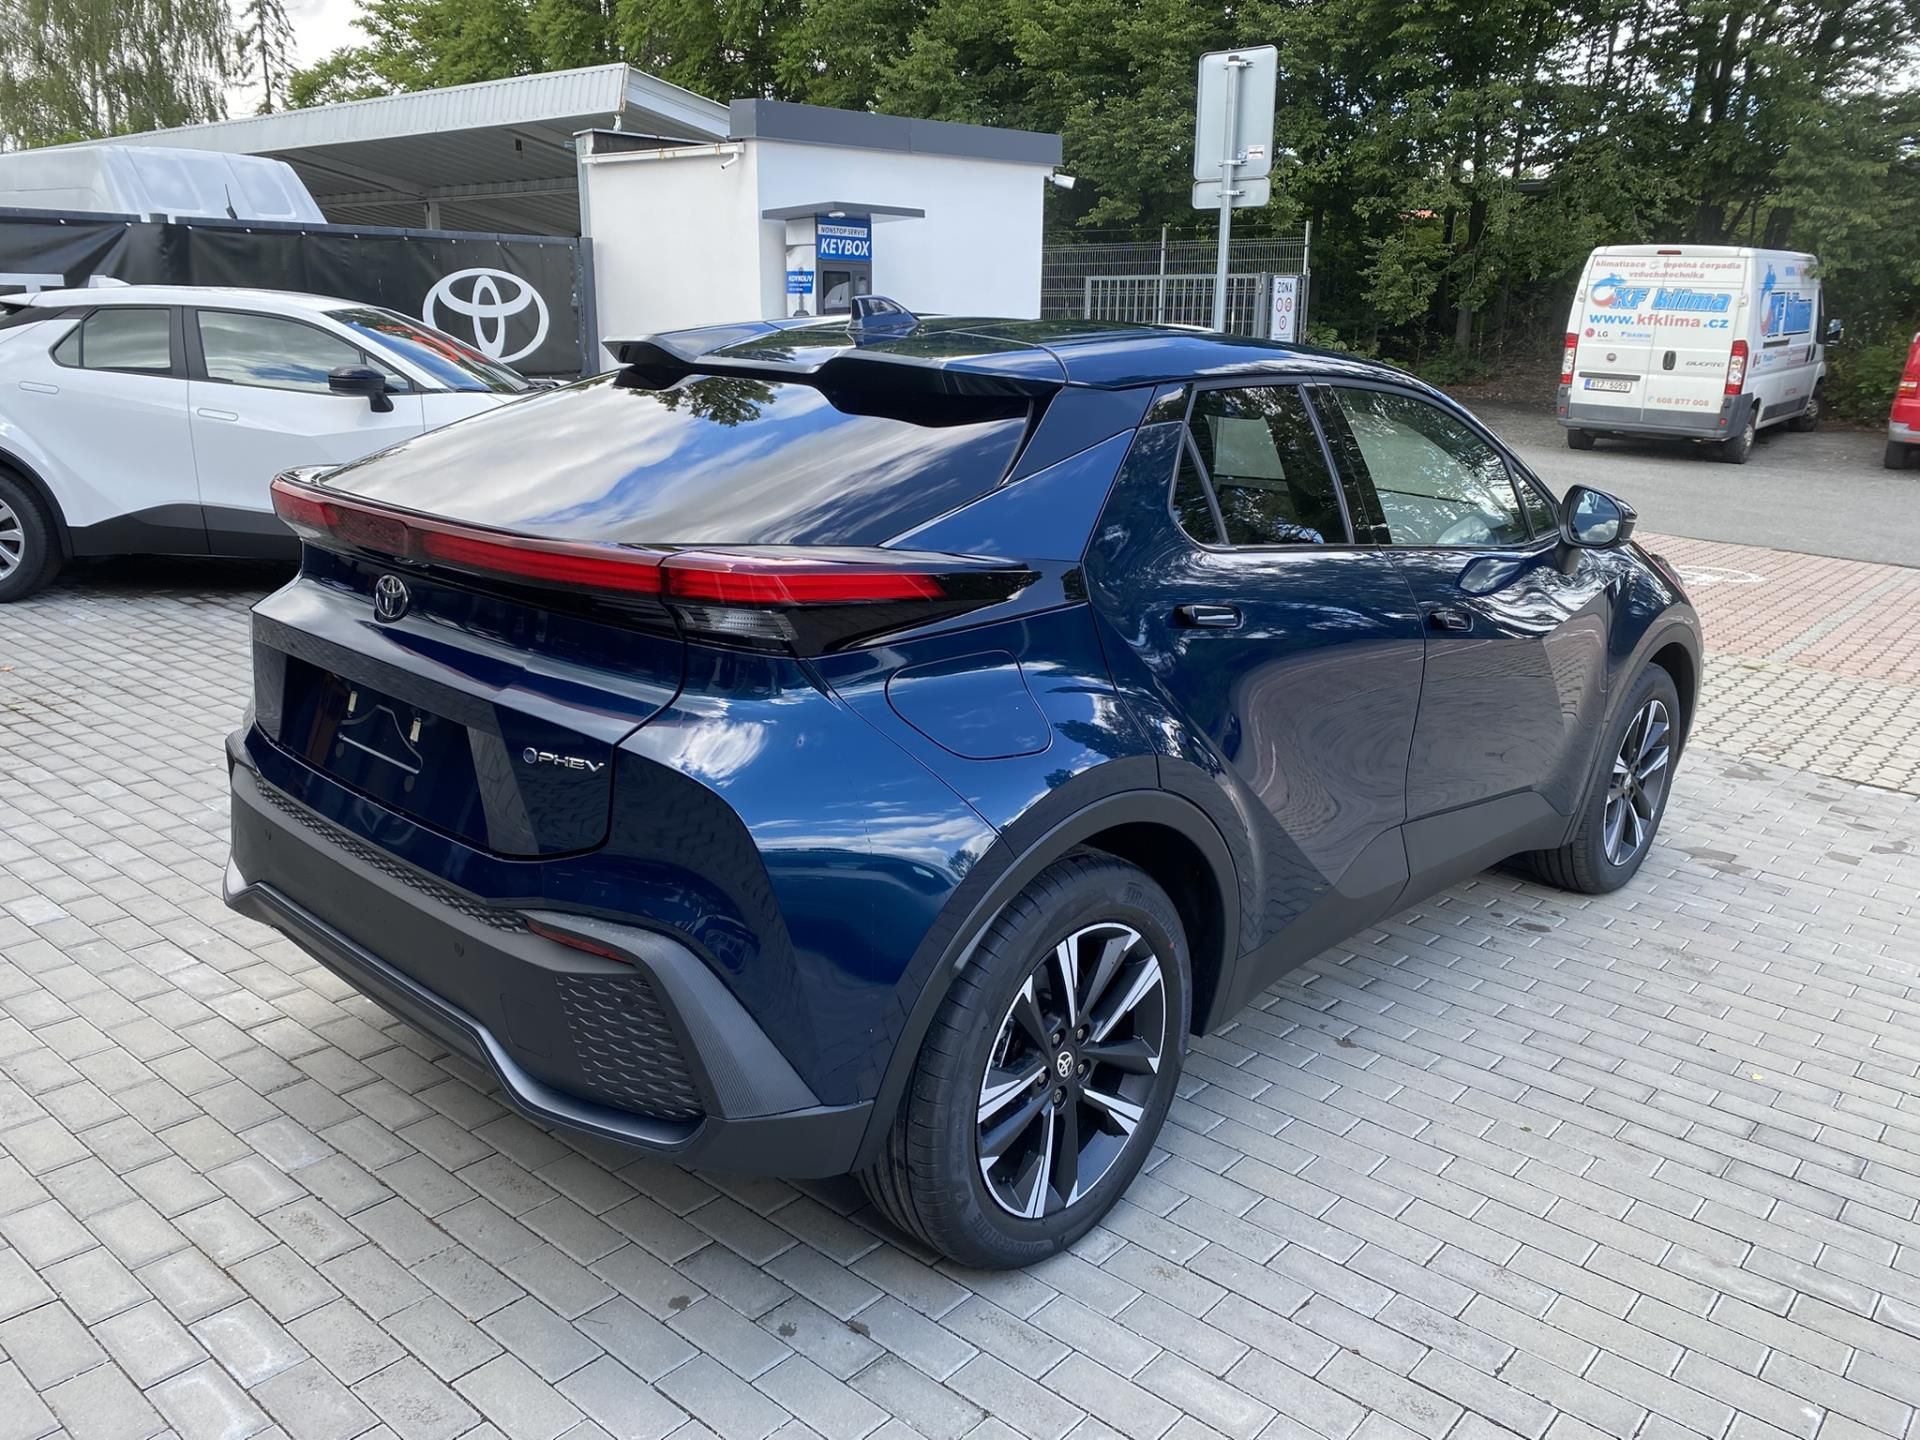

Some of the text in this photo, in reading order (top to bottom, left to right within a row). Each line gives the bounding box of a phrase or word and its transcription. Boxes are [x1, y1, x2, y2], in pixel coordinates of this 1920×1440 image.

[820, 238, 870, 257] KEYBOX
[1595, 260, 1646, 268] klimatizace
[1277, 281, 1293, 293] ZONA
[1610, 287, 1732, 313] KF klima
[1589, 313, 1729, 329] www.kfklima.cz
[1597, 330, 1609, 338] LG
[538, 751, 605, 773] PHEV
